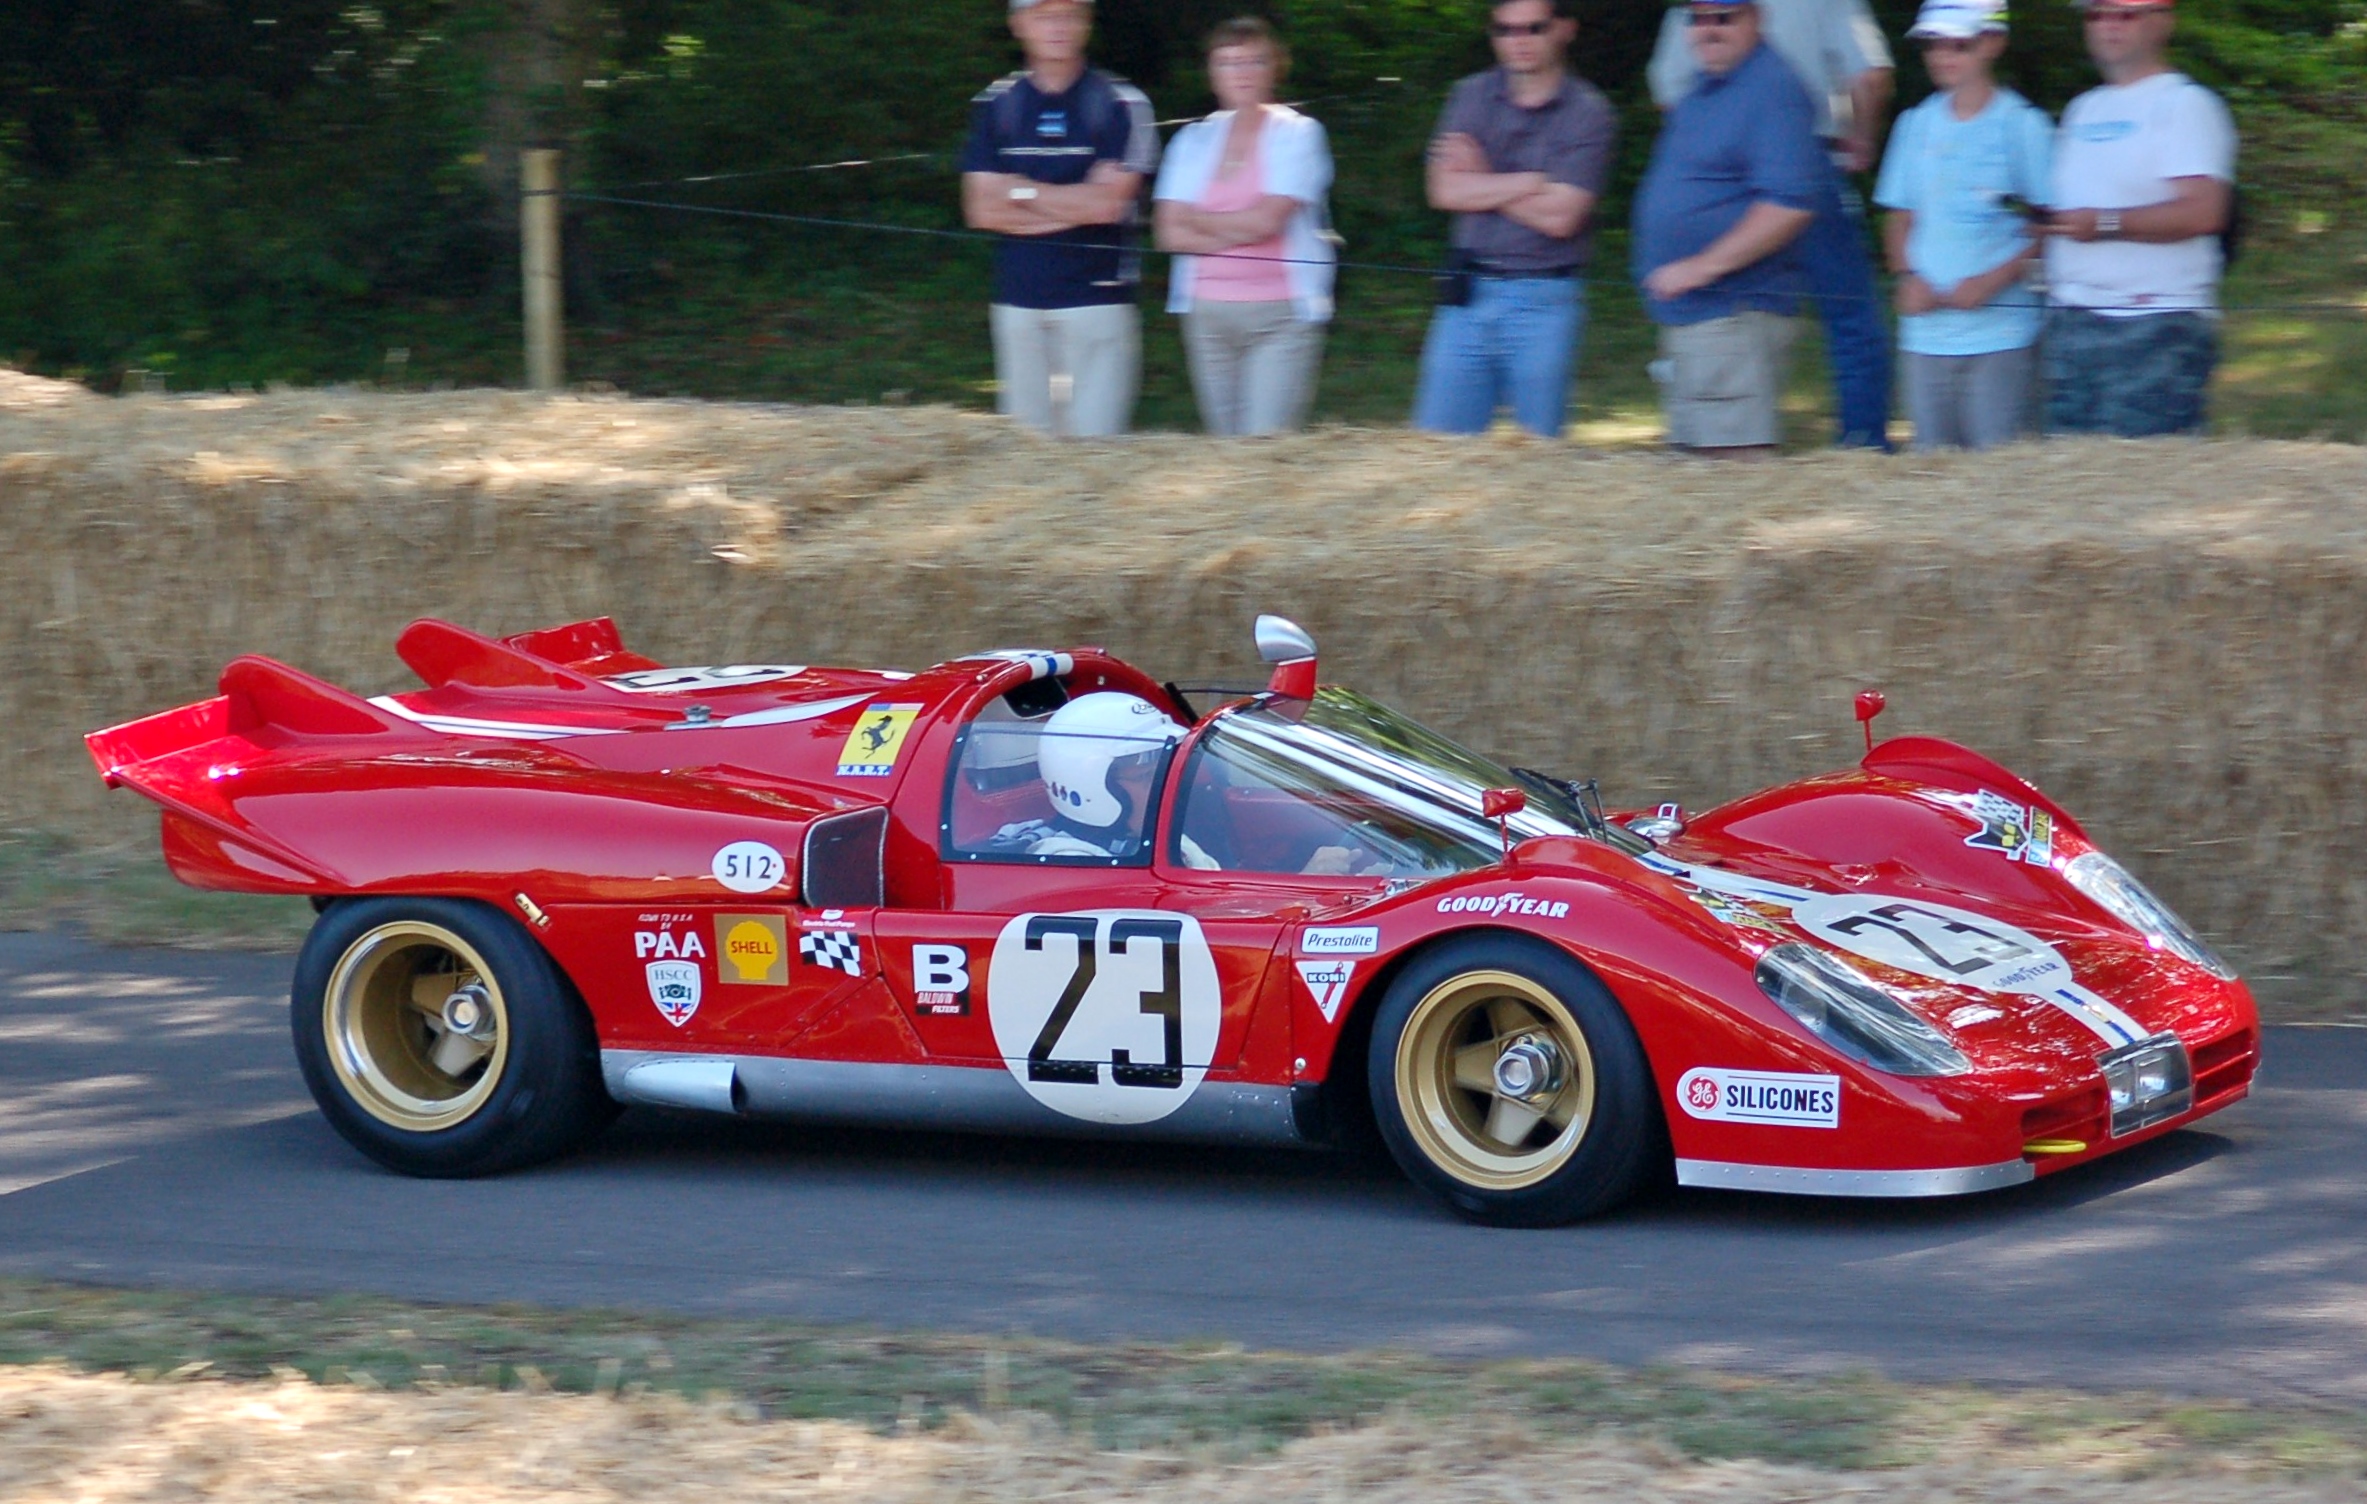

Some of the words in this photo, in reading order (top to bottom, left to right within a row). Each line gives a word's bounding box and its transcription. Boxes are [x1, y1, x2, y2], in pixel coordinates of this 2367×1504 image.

[725, 854, 772, 879] 512
[1436, 892, 1570, 918] GOODYEAR
[634, 931, 706, 958] PAA
[731, 941, 773, 955] SHELL
[1307, 932, 1373, 947] Prestolite
[1826, 903, 2033, 975] 23
[654, 969, 693, 981] HSCC
[912, 944, 969, 993] B
[1307, 973, 1345, 983] KONI
[1992, 962, 2061, 987] GOODYEAR
[1025, 915, 1184, 1090] 23
[1726, 1084, 1834, 1114] SILICONES
